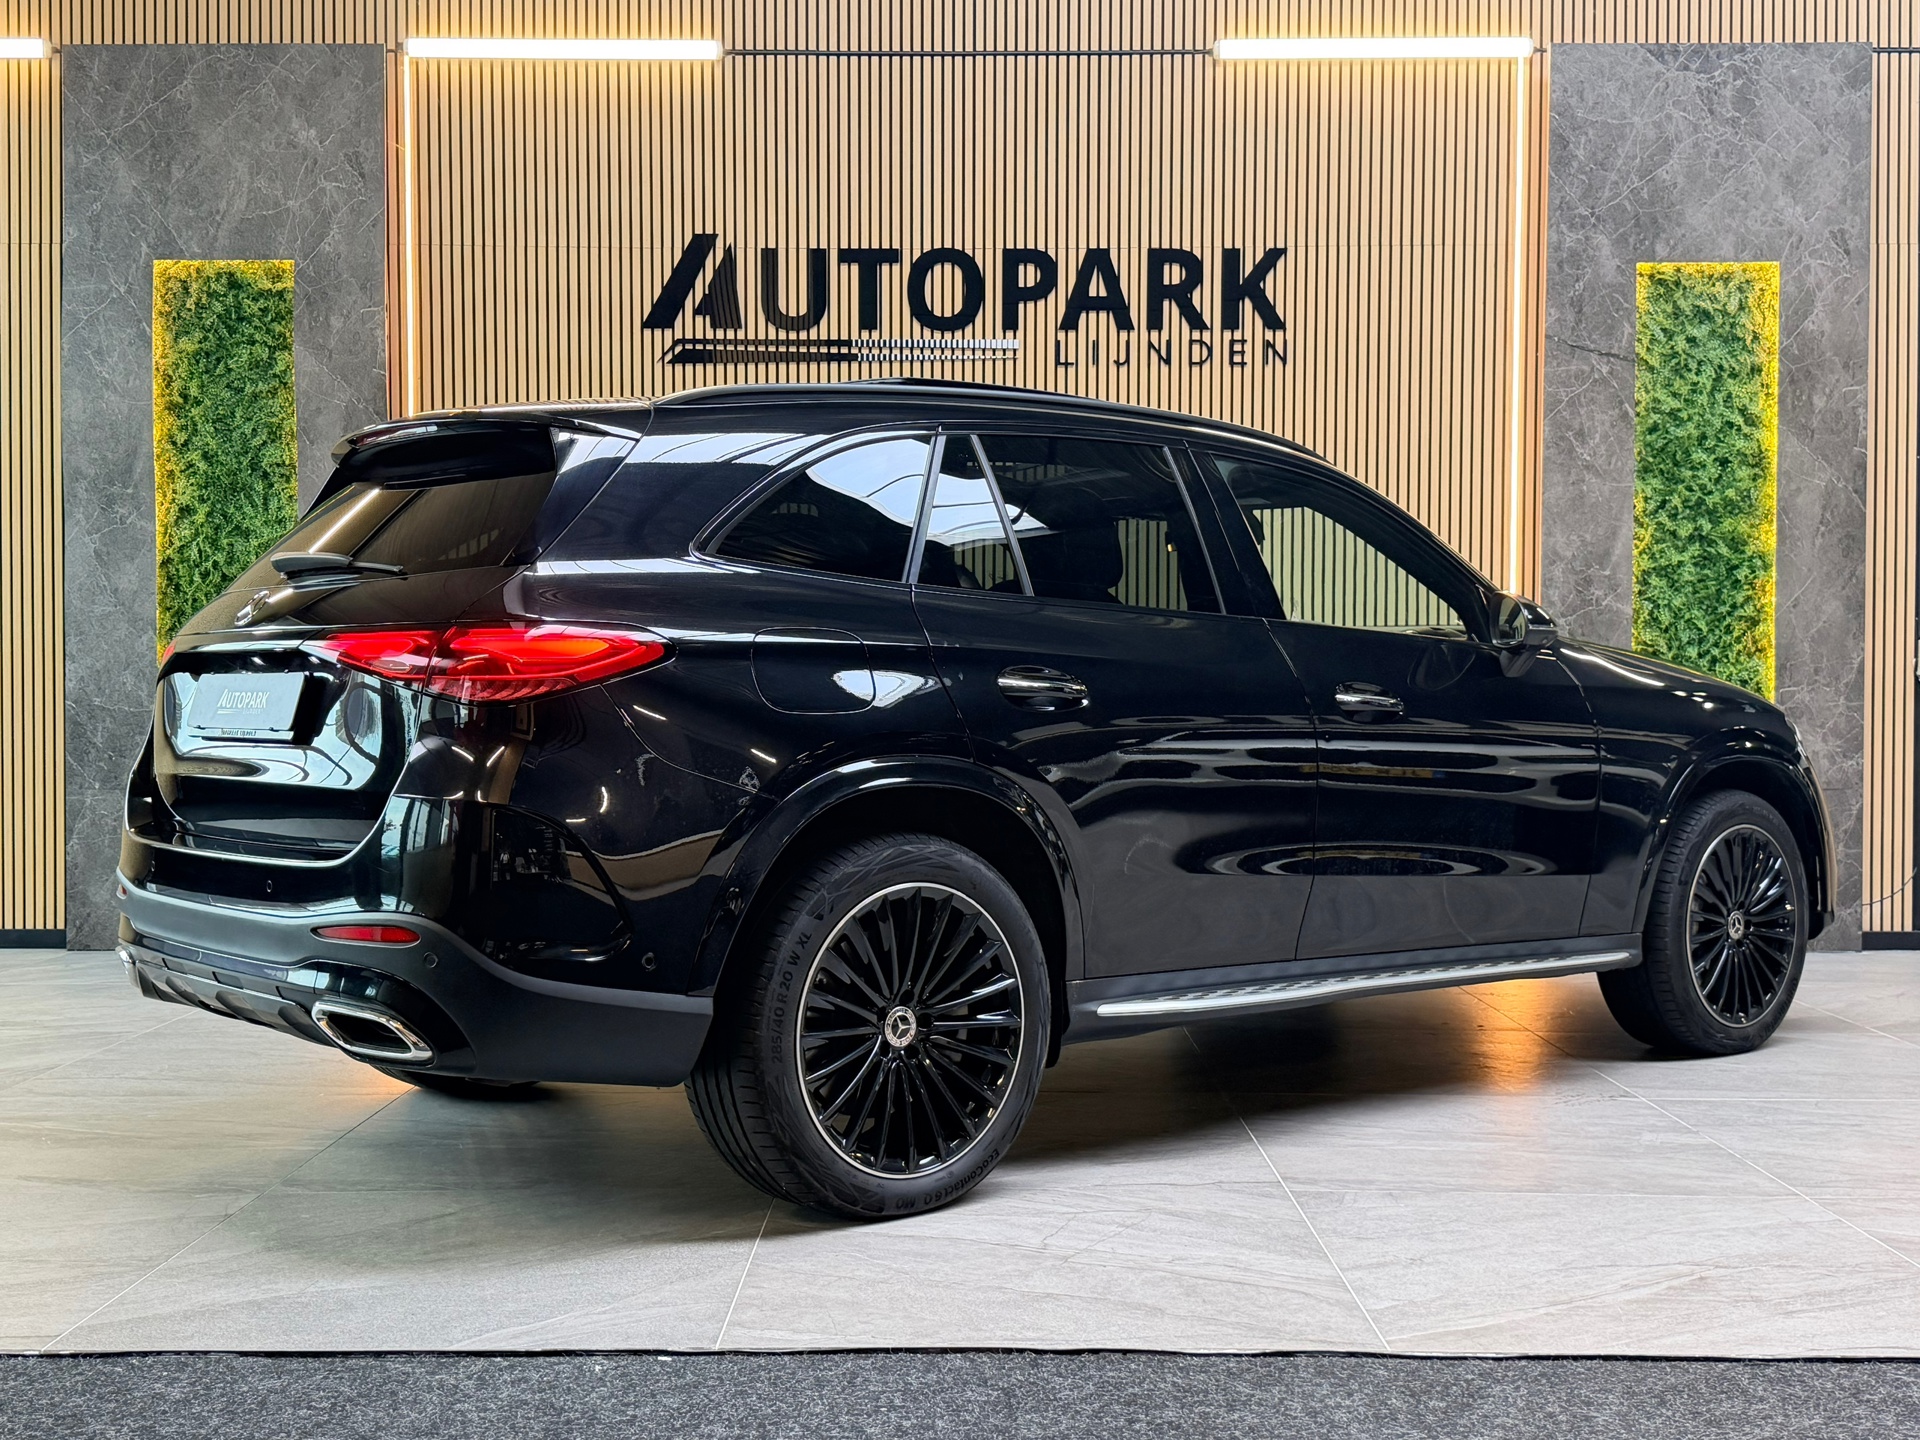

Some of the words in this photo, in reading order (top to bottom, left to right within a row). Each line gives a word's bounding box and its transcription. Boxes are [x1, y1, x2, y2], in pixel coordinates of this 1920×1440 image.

[641, 233, 1288, 331] AUTOPARK
[1055, 337, 1289, 367] LIJNDEN
[216, 689, 270, 709] AUTOPARK
[796, 932, 812, 949] XL
